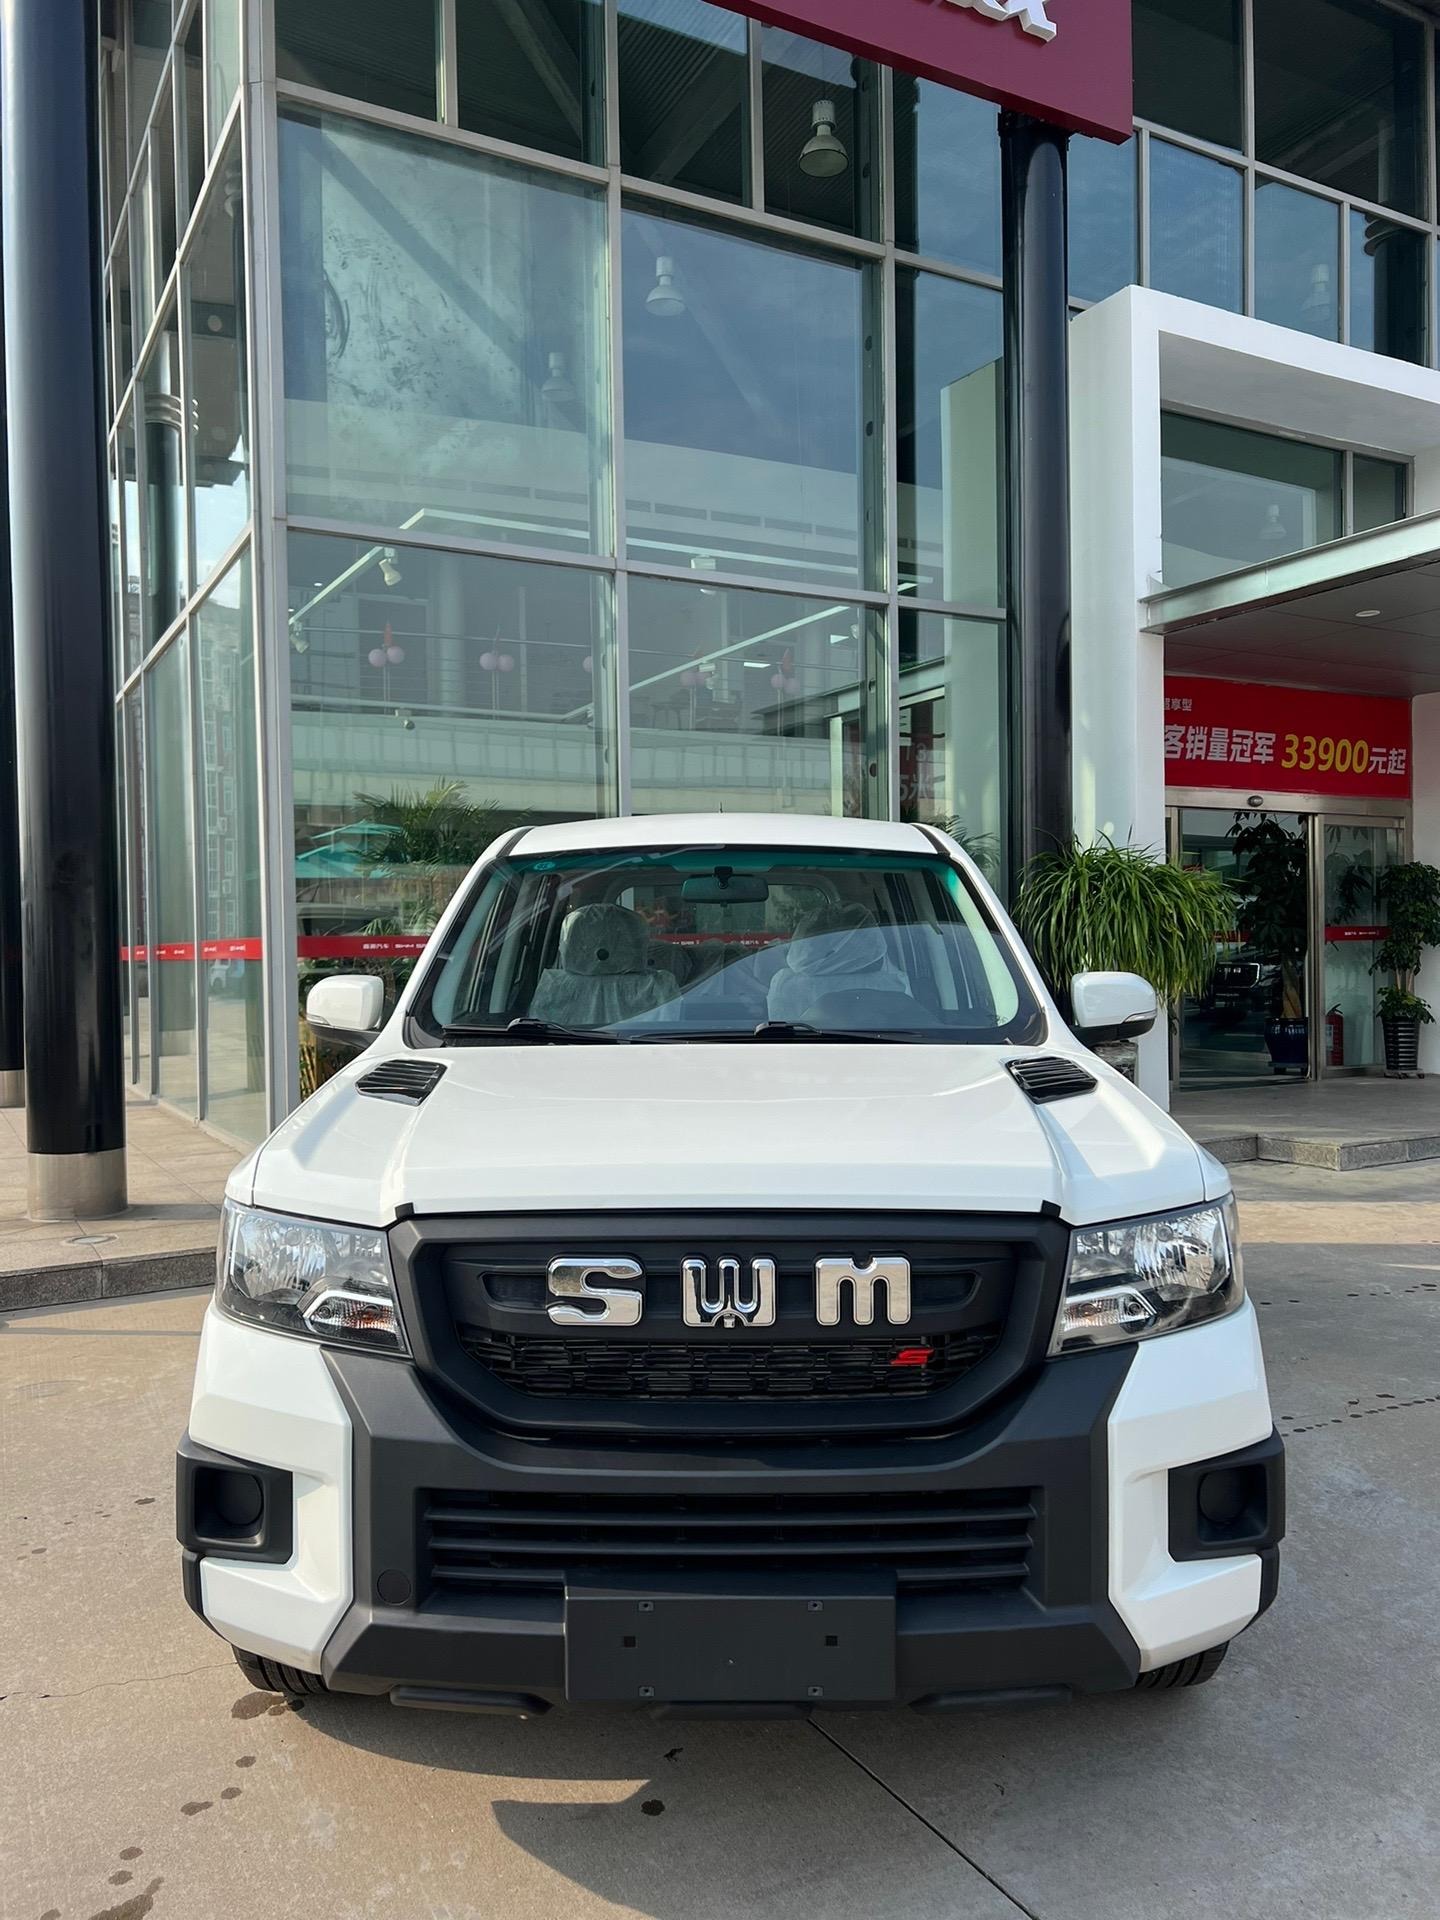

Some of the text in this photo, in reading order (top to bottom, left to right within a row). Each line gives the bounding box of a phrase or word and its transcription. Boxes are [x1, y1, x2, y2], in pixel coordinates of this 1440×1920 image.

[1164, 724, 1276, 764] 客销量冠军
